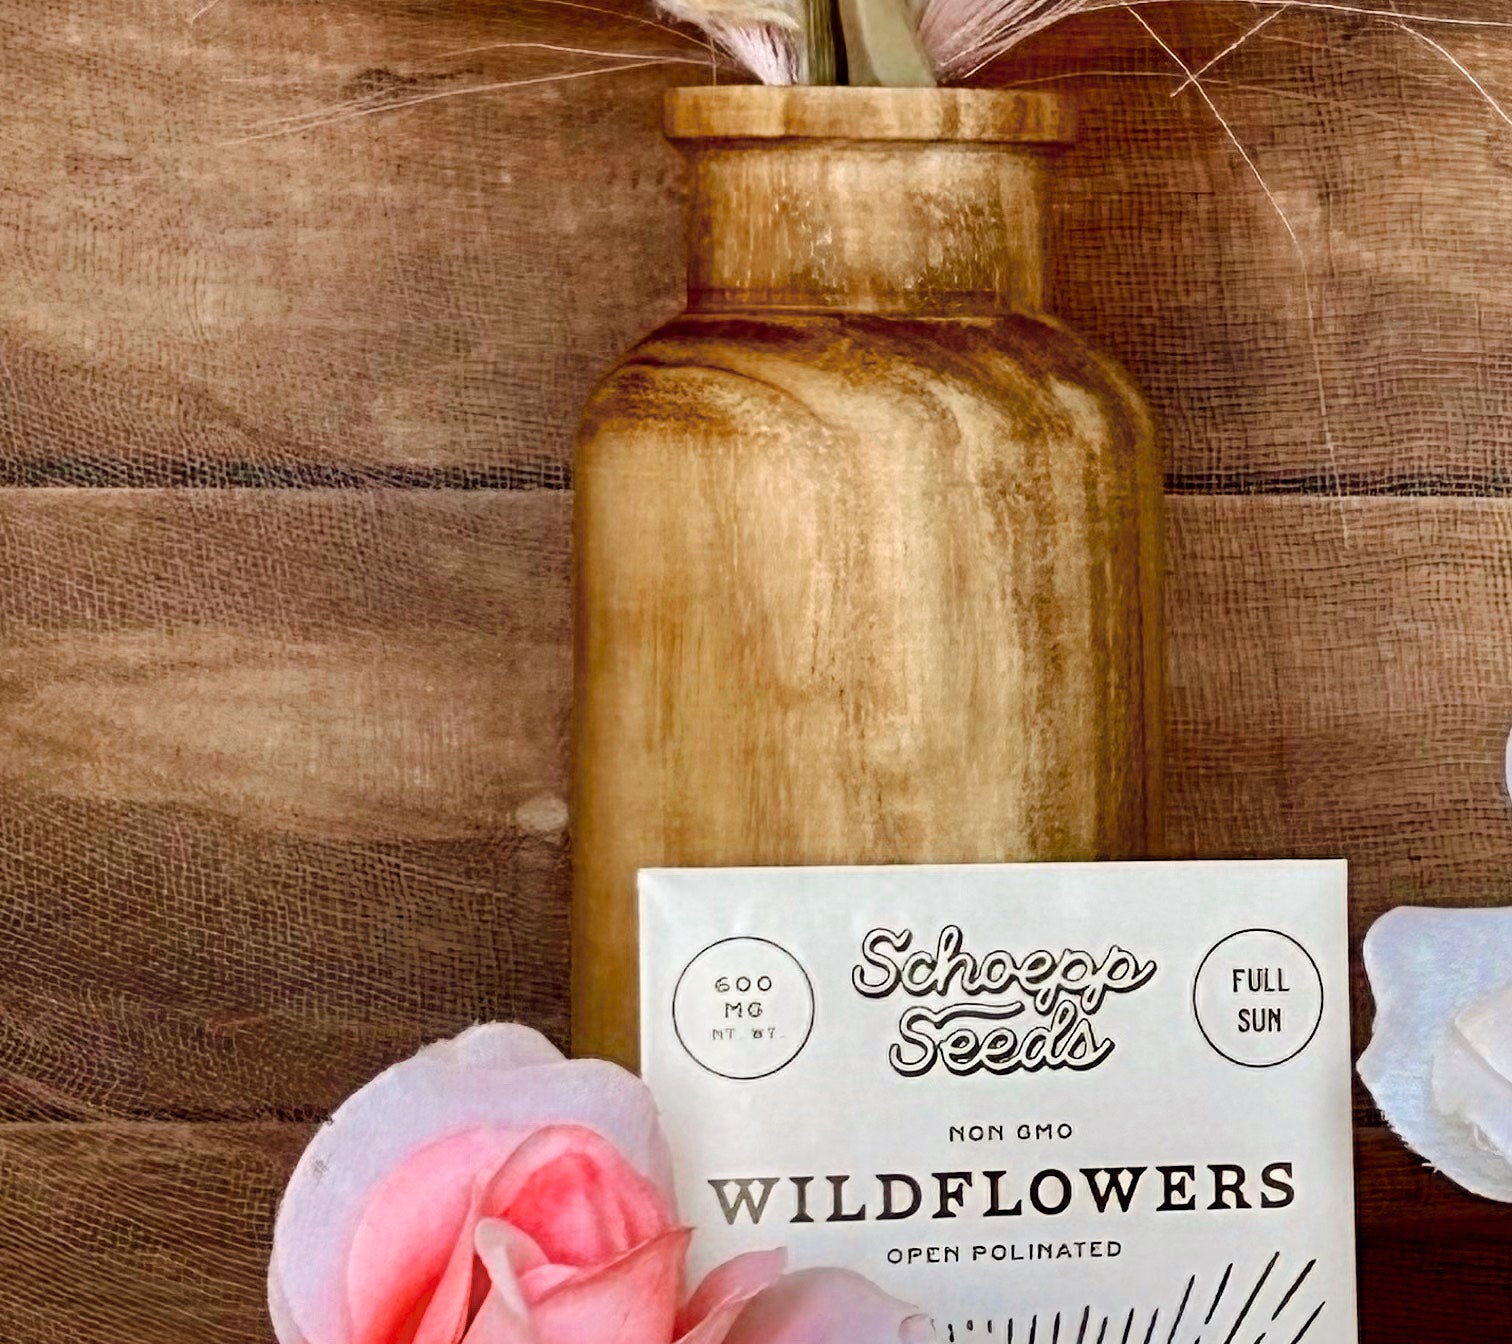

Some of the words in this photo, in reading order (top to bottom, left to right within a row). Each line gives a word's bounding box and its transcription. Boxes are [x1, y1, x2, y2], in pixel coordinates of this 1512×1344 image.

[852, 924, 1157, 1014] Schoepp
[1232, 967, 1291, 994] FULL
[724, 1001, 763, 1019] MG
[1237, 1008, 1282, 1033] SUN
[889, 999, 1116, 1078] Seeds
[949, 1124, 1004, 1143] NON
[1017, 1122, 1074, 1141] GMO
[707, 1160, 1296, 1226] WILDFLOWERS
[886, 1245, 960, 1265] OPEN
[971, 1240, 1123, 1263] POLINATED
